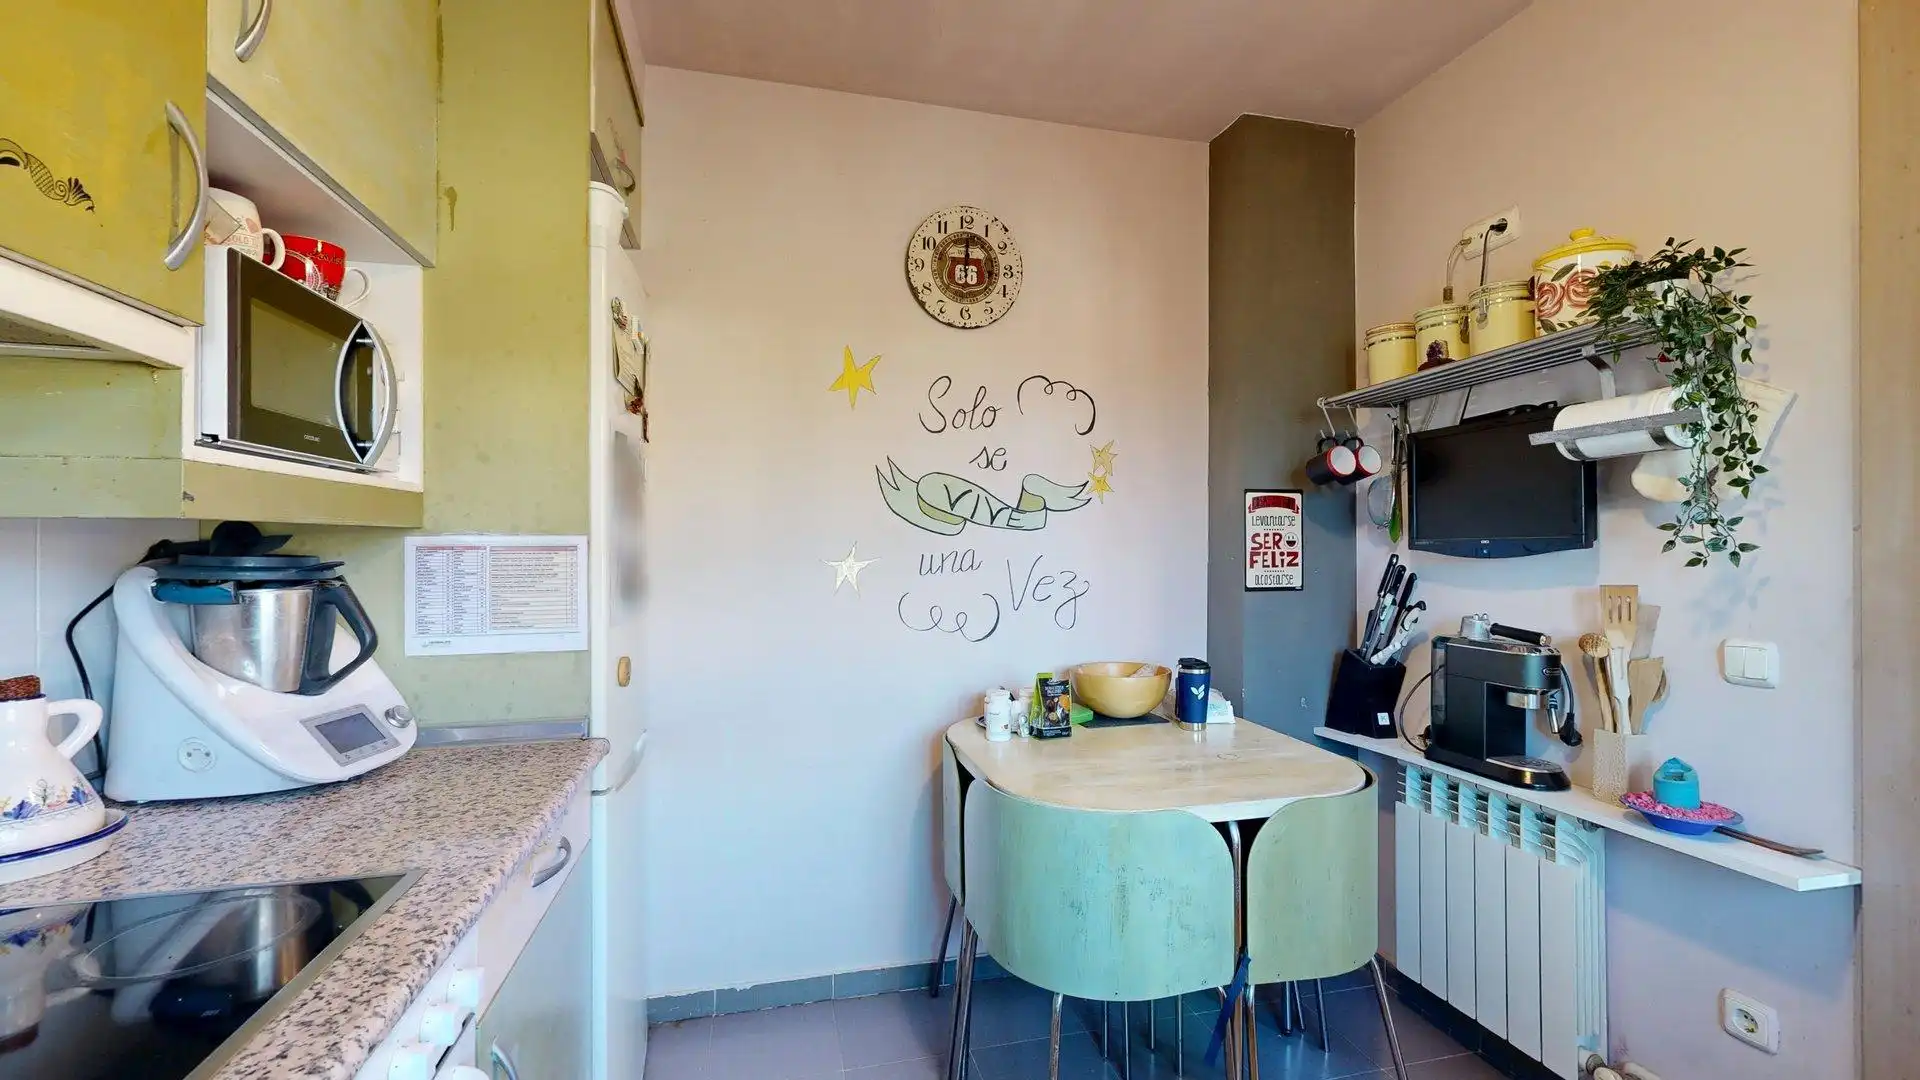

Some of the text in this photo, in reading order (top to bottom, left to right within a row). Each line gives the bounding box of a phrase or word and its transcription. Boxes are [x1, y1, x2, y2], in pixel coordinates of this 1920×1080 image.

[937, 220, 948, 234] 11
[960, 215, 974, 230] 12
[984, 224, 989, 238] 1
[922, 236, 936, 250] 10
[997, 241, 1008, 255] 2
[914, 257, 925, 272] 9
[1002, 265, 1014, 279] 3
[954, 264, 978, 285] 66
[921, 282, 932, 295] 8
[996, 284, 1009, 298] 4
[936, 299, 946, 314] 7
[959, 305, 971, 320] 6
[984, 300, 994, 315] 5
[918, 375, 1003, 434] Solo
[968, 445, 1007, 471] se
[943, 484, 1028, 529] VIVE
[1250, 532, 1283, 551] SER
[1254, 574, 1294, 586] acostarse
[918, 548, 1090, 631] una Vez
